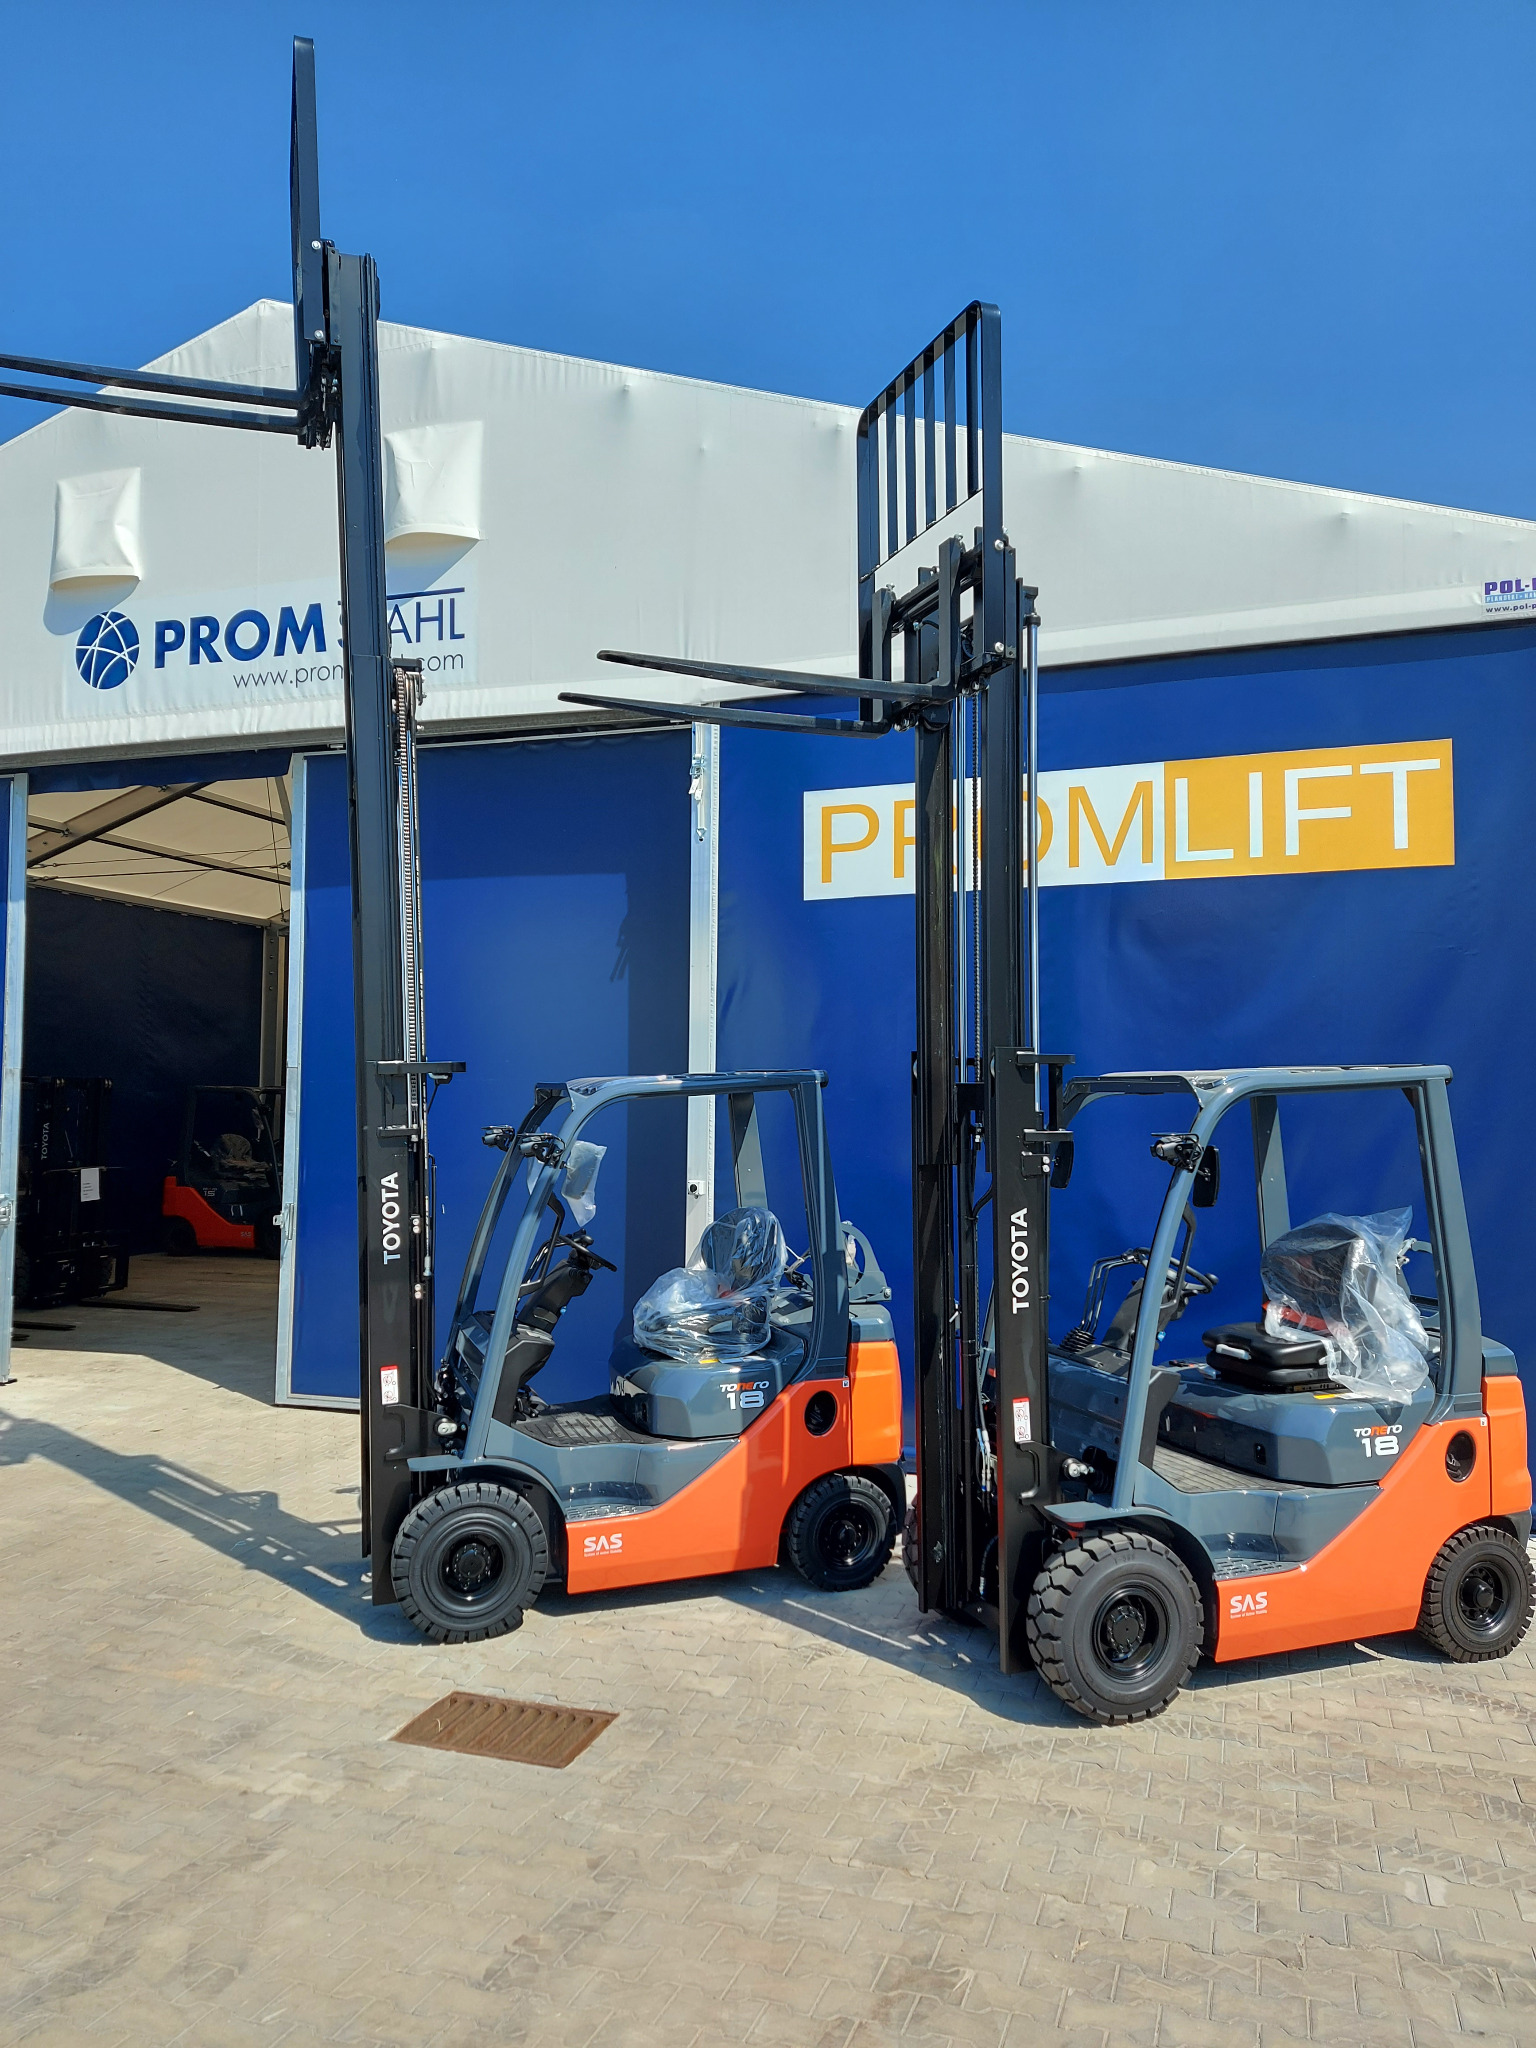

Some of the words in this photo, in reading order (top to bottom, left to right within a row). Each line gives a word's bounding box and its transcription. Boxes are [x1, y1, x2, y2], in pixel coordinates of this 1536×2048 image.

[154, 587, 465, 669] PROMAHL
[41, 1122, 50, 1160] TOYOTA
[381, 1171, 401, 1265] TOYOTA
[1010, 1207, 1030, 1315] TOYOTA
[726, 1391, 765, 1410] 18
[1361, 1435, 1400, 1458] 18
[584, 1533, 623, 1553] SAS
[1230, 1591, 1268, 1614] SAS
